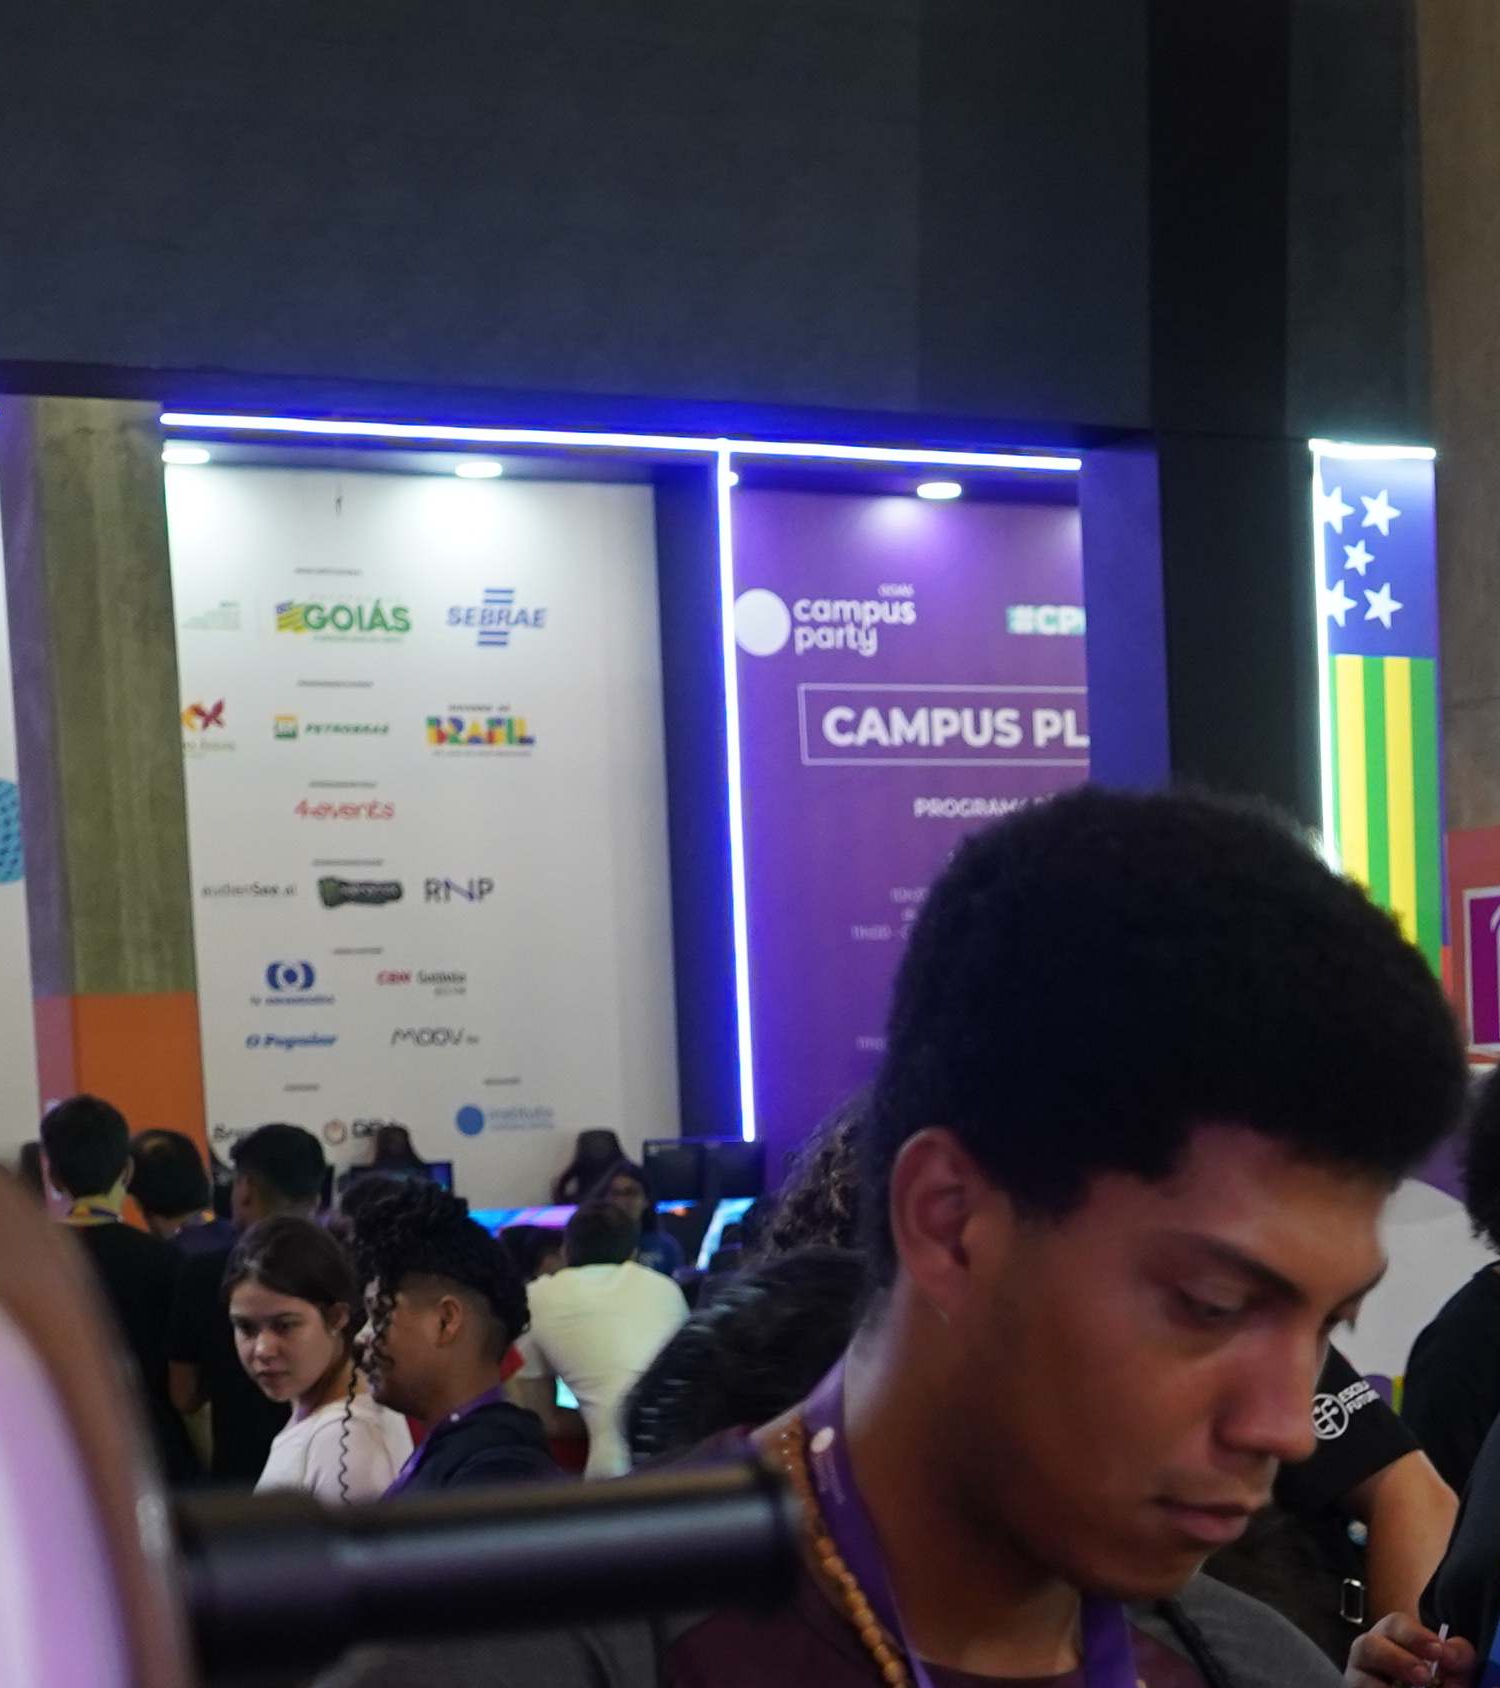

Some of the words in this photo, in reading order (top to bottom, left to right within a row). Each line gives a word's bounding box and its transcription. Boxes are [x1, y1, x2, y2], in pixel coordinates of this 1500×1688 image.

[302, 600, 412, 634] GOIÁS
[447, 606, 547, 629] SEBRAE
[793, 599, 917, 626] campus
[794, 623, 879, 657] party
[822, 706, 1023, 748] CAMPUS
[424, 876, 494, 903] RNP
